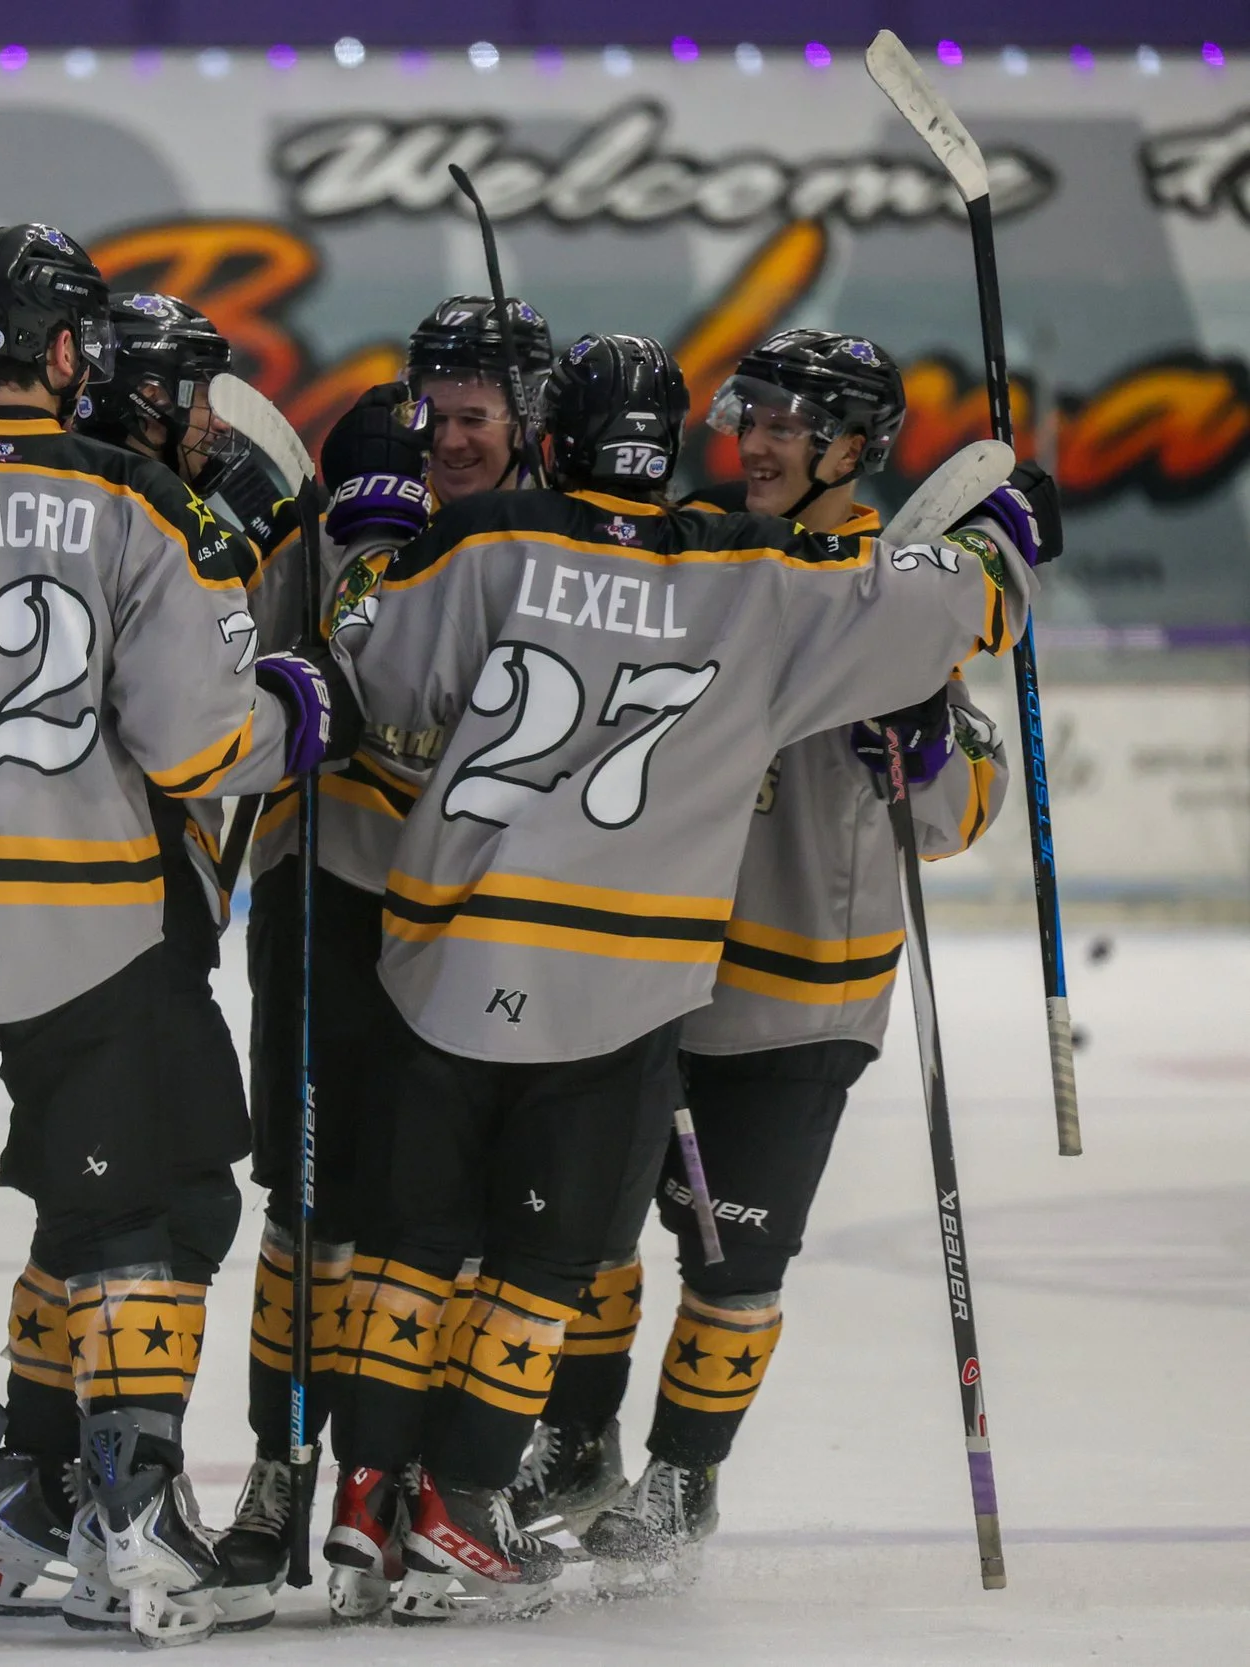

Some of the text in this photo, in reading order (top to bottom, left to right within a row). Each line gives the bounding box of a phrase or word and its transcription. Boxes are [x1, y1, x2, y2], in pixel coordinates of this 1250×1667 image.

[272, 102, 1053, 224] Welcome
[131, 341, 178, 350] BAUER
[441, 311, 473, 326] 17
[129, 392, 161, 419] BAUER
[614, 446, 651, 475] 27
[250, 516, 271, 539] RMY
[516, 558, 688, 639] LEXELL
[441, 640, 720, 830] 27
[1026, 691, 1055, 877] JETSPEED
[305, 1082, 316, 1209] BAUER
[664, 1178, 769, 1227] BAER
[941, 1212, 969, 1321] BAUER
[291, 1389, 302, 1448] AUER
